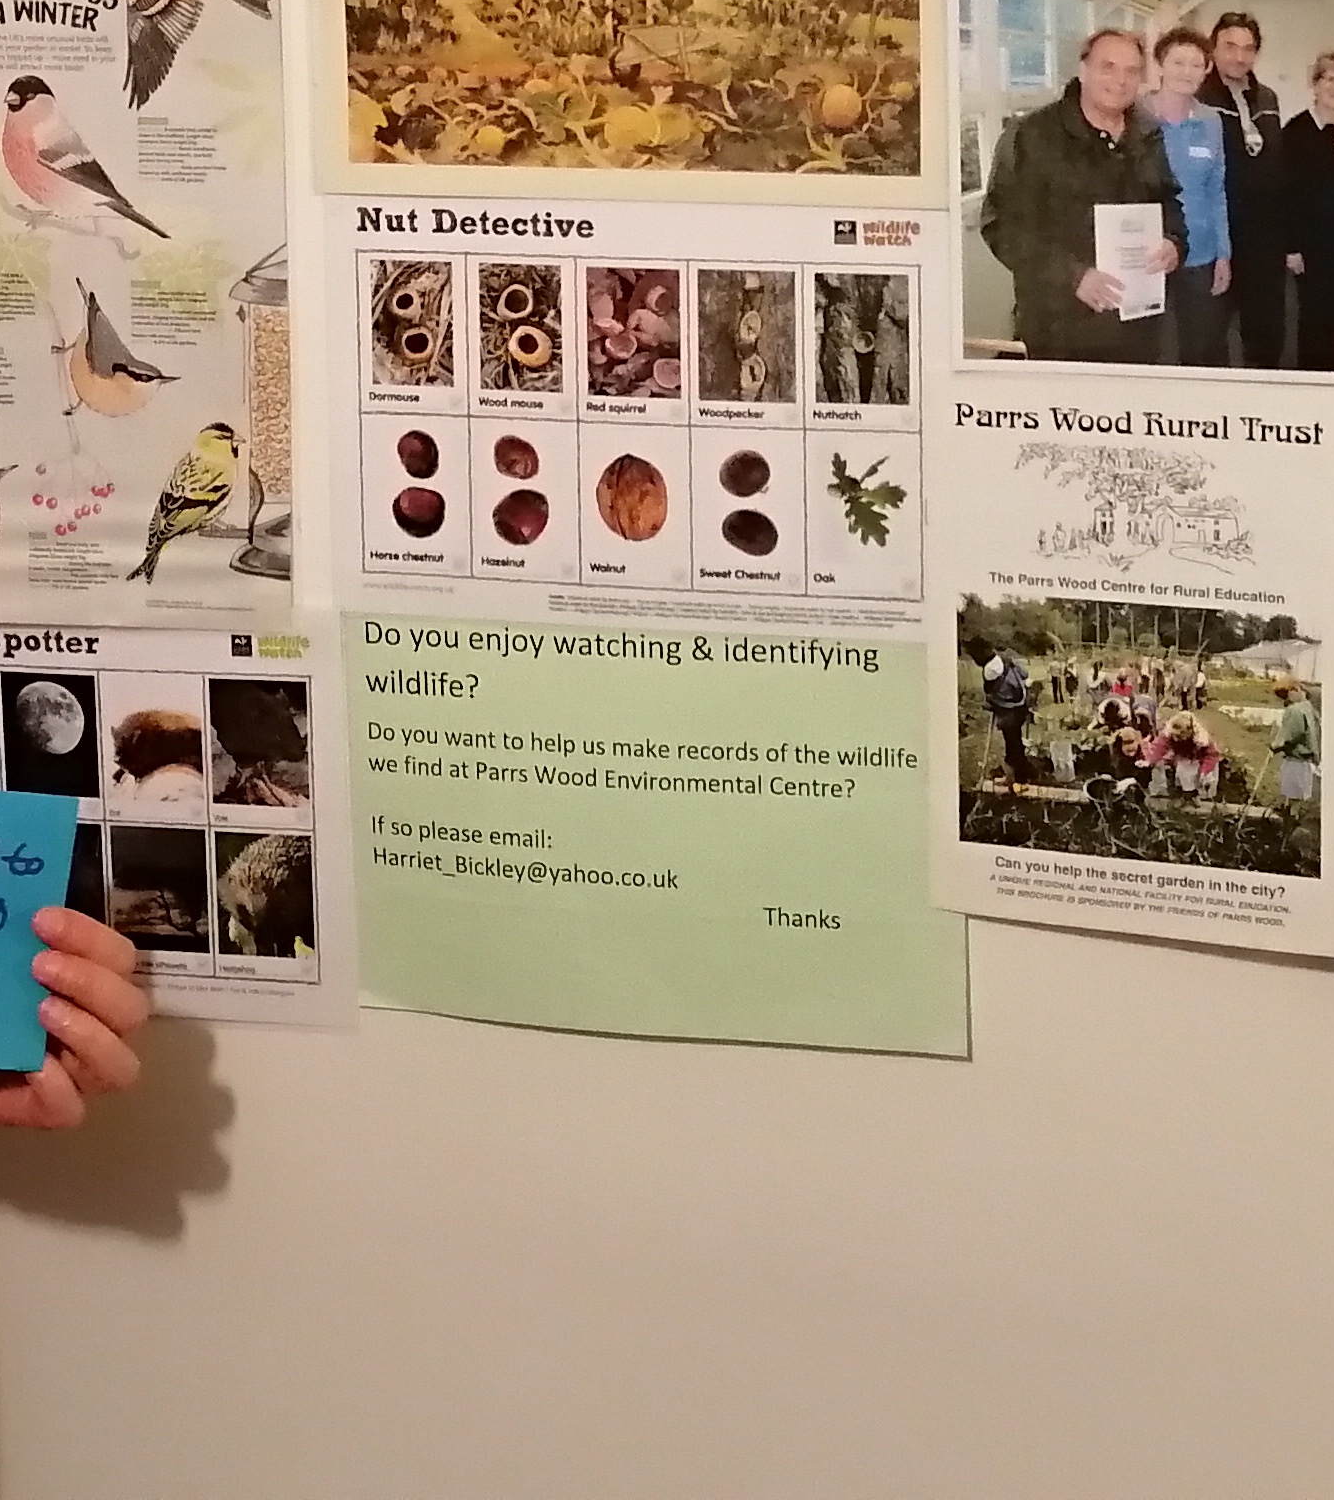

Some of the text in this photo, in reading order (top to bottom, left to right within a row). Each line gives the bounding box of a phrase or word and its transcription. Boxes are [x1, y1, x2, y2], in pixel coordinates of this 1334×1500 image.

[356, 206, 594, 239] Nut Detective
[368, 391, 421, 403] Dormouse
[478, 396, 544, 410] Wood mouse
[585, 401, 647, 416] Red squirrel
[698, 407, 765, 421] Woodpecker
[812, 409, 862, 421] Nuthatch
[955, 402, 1324, 446] Parrs Wood Rural Trust
[369, 550, 445, 563] Horse chestnut
[481, 556, 526, 569] Hazelnut
[589, 562, 626, 575] Walnut
[699, 567, 781, 582] Sweet Chestnut
[813, 572, 836, 584] Oak
[989, 571, 1286, 605] The Parrs Wood Centre for Rural Education
[364, 620, 880, 674] Do you enjoy watching & identifying
[365, 668, 479, 699] wildlife?
[371, 814, 552, 850] If so please email:
[2, 842, 46, 876] to
[373, 846, 679, 890] Harriet_Bickley@yahoo.co.uk
[994, 856, 1286, 901] Can you help the secret garden in the city?
[762, 906, 841, 931] Thanks
